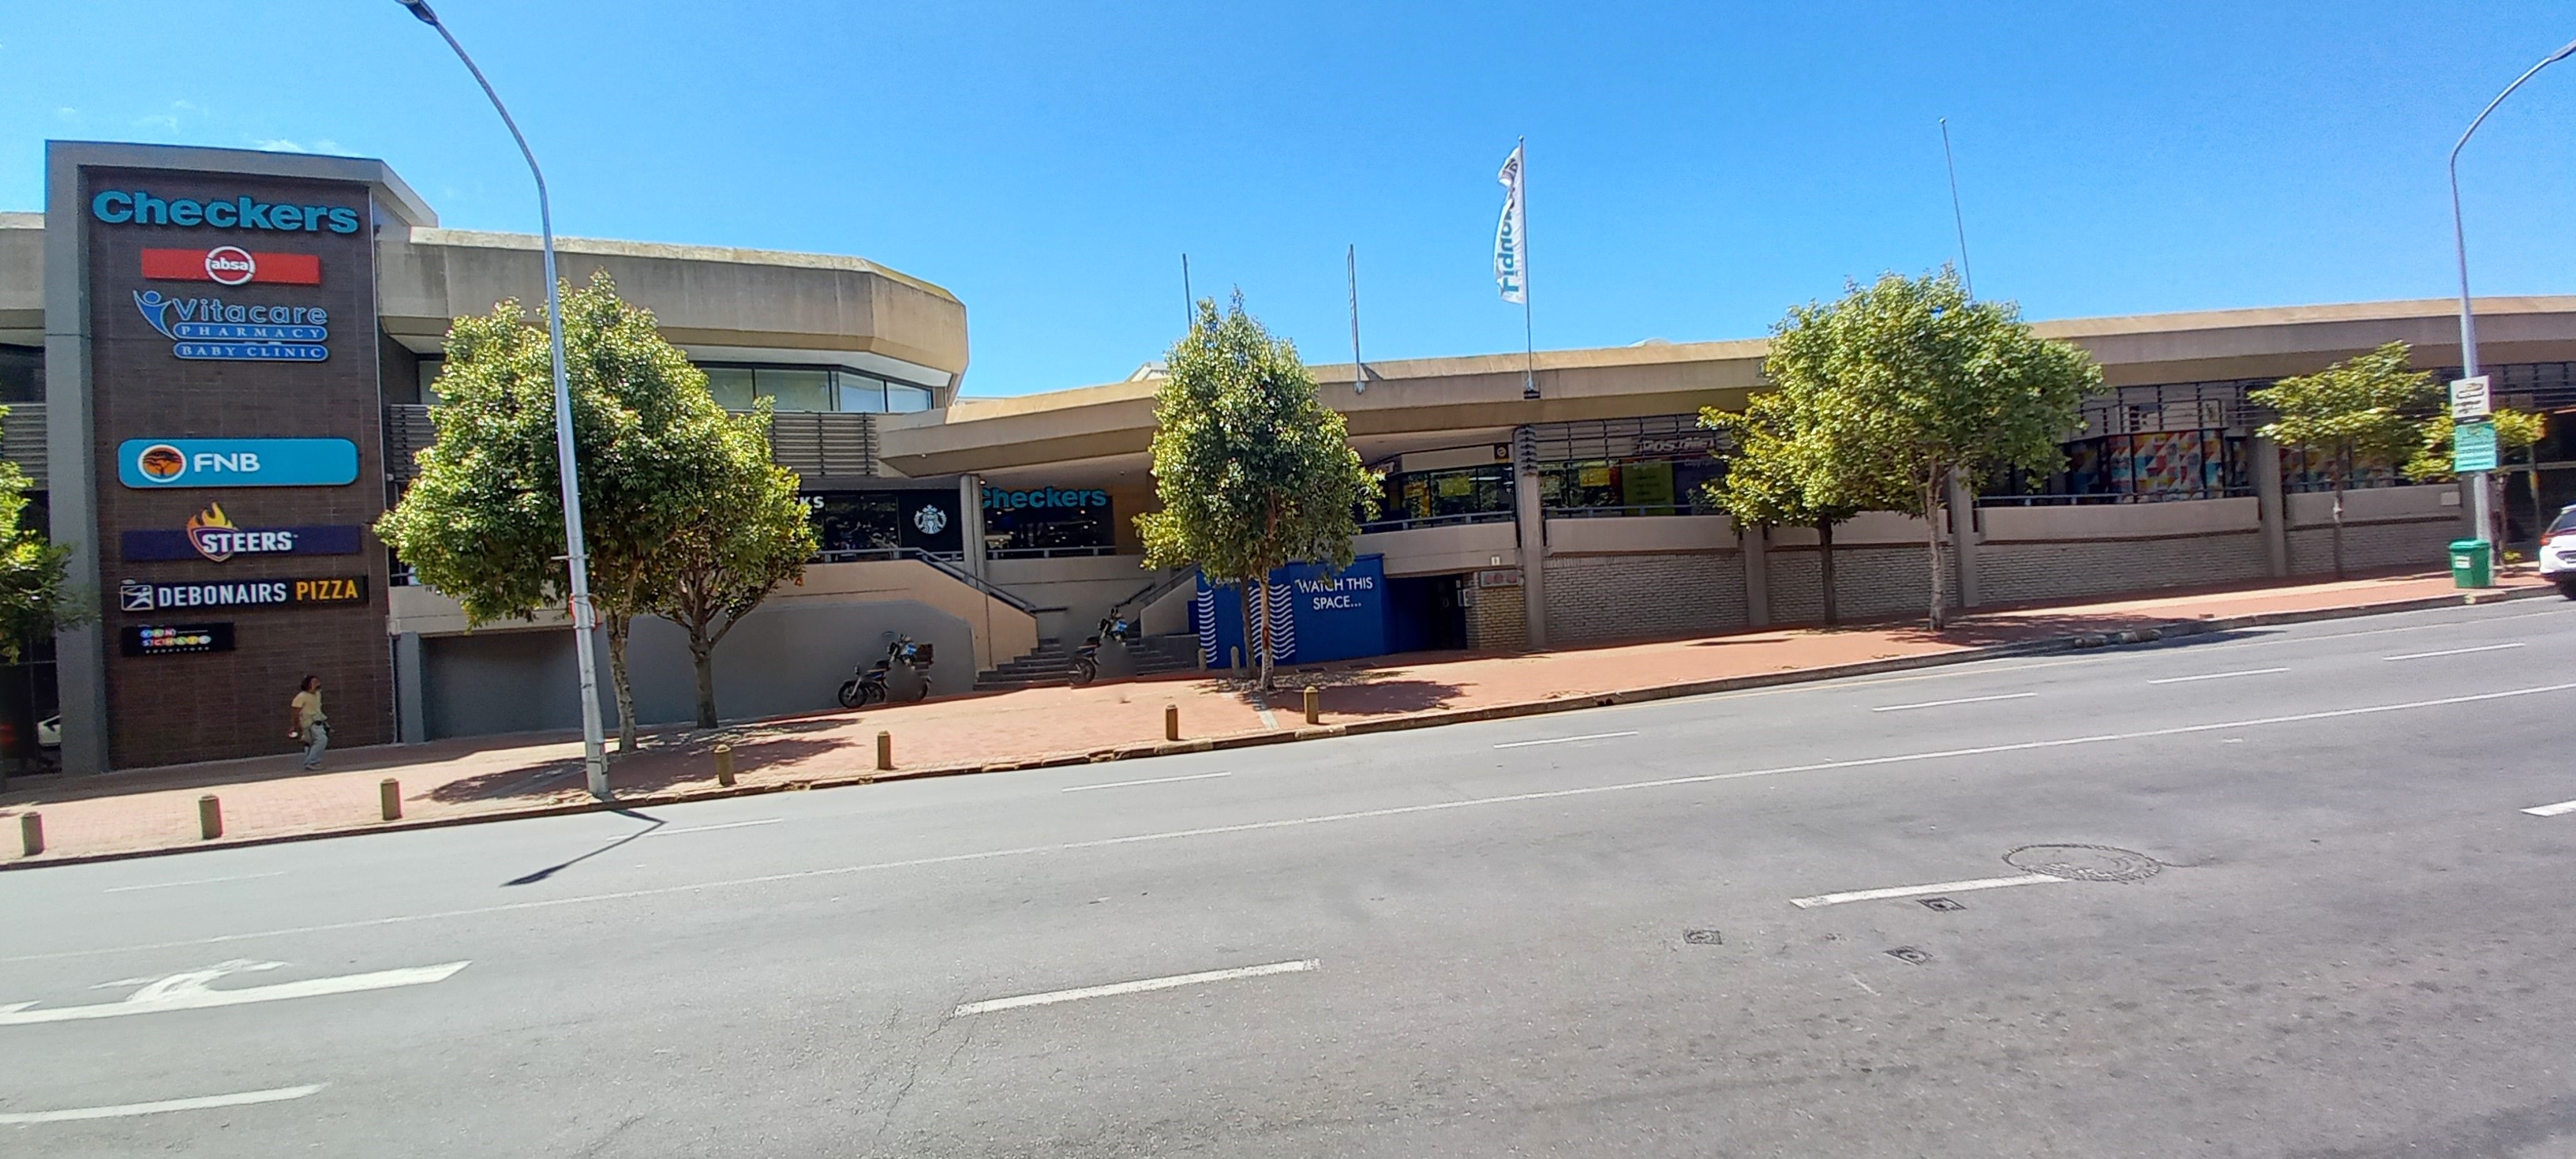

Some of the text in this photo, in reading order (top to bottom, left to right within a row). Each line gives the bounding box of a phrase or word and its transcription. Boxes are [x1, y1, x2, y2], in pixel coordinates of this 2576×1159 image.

[92, 189, 359, 234] Checkers
[212, 257, 249, 272] absa
[172, 298, 328, 324] Vitacare
[182, 325, 320, 339] PHARMACY
[182, 345, 322, 358] BABY CLINIC
[193, 452, 260, 472] FNB
[202, 531, 293, 553] STEERS
[1346, 576, 1373, 591] THIS
[159, 579, 358, 607] DEBONAIRS PIZZA
[1312, 595, 1361, 610] SPACE...
